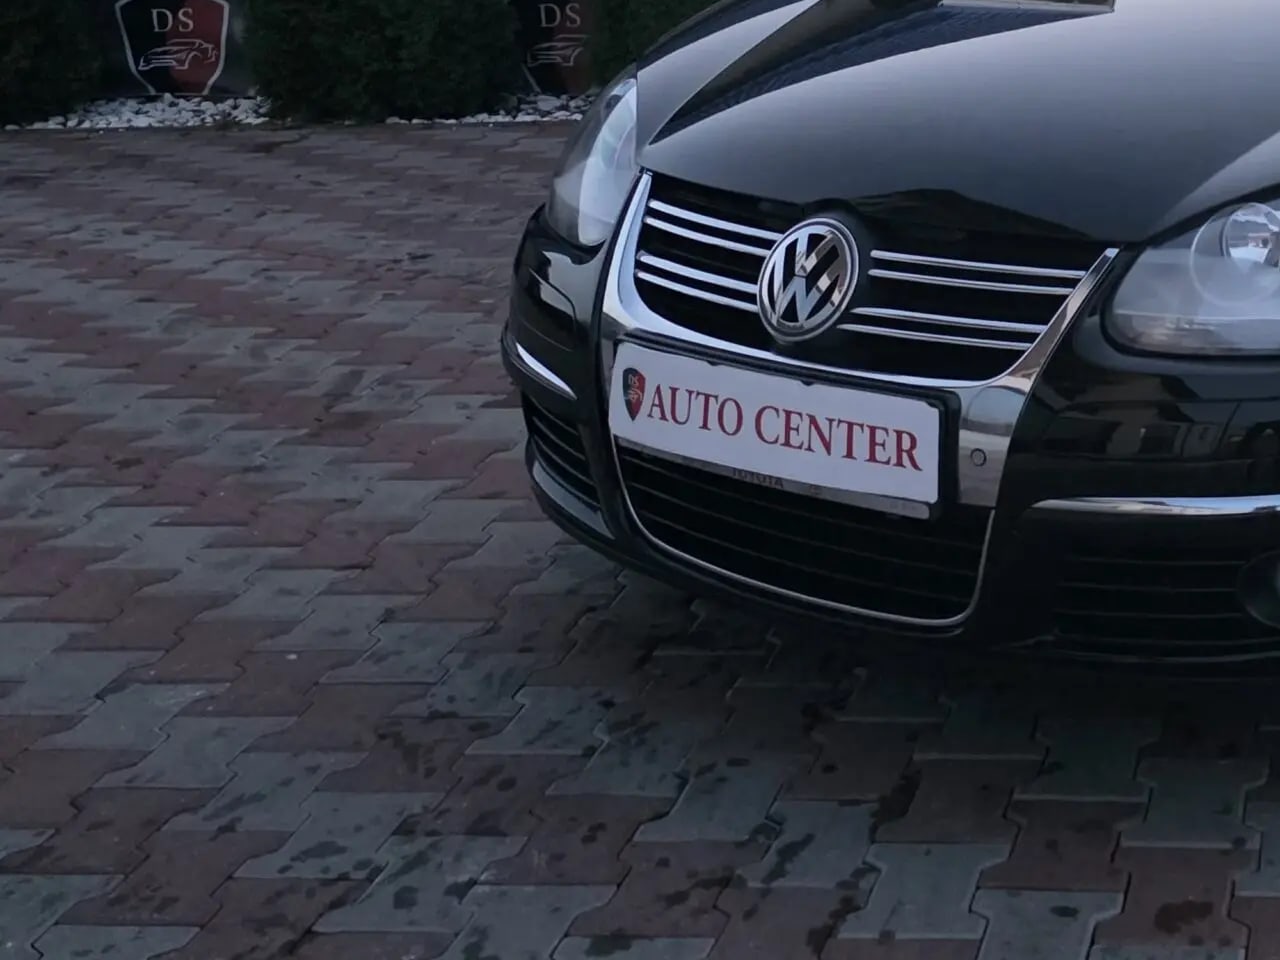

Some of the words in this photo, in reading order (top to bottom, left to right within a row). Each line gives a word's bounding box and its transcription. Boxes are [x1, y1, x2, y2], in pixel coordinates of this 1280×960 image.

[151, 8, 195, 32] DS
[539, 3, 581, 28] DS
[647, 384, 743, 436] AUTO
[755, 405, 923, 471] CENTER
